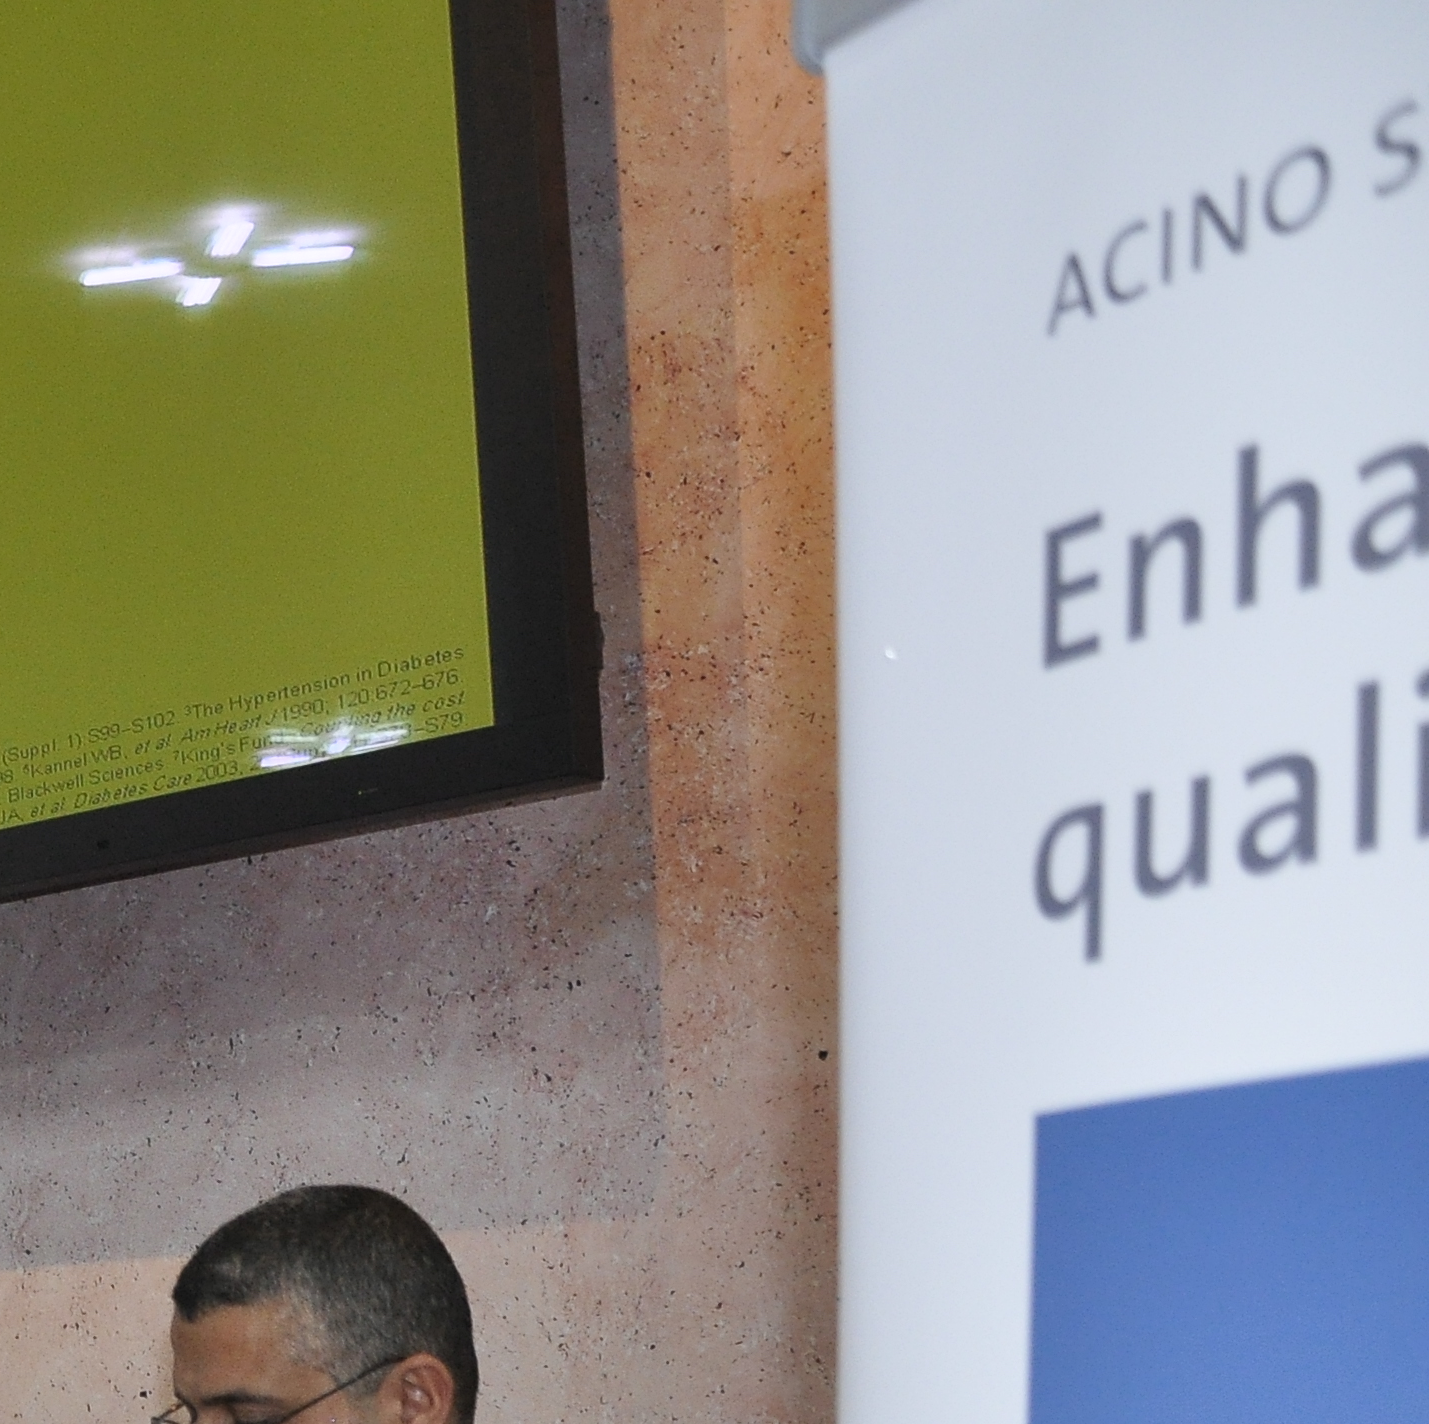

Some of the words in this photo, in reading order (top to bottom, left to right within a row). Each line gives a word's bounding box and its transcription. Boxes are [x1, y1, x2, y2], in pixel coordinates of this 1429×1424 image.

[1045, 143, 1331, 338] ACINO
[1043, 439, 1429, 671] Enha
[228, 673, 350, 712] Hypertension
[376, 647, 464, 676] Diabetes
[7, 772, 83, 802] Blackwell
[386, 702, 415, 720] the
[213, 711, 262, 736] Heart
[72, 784, 148, 809] Diabetes
[152, 774, 192, 792] Care
